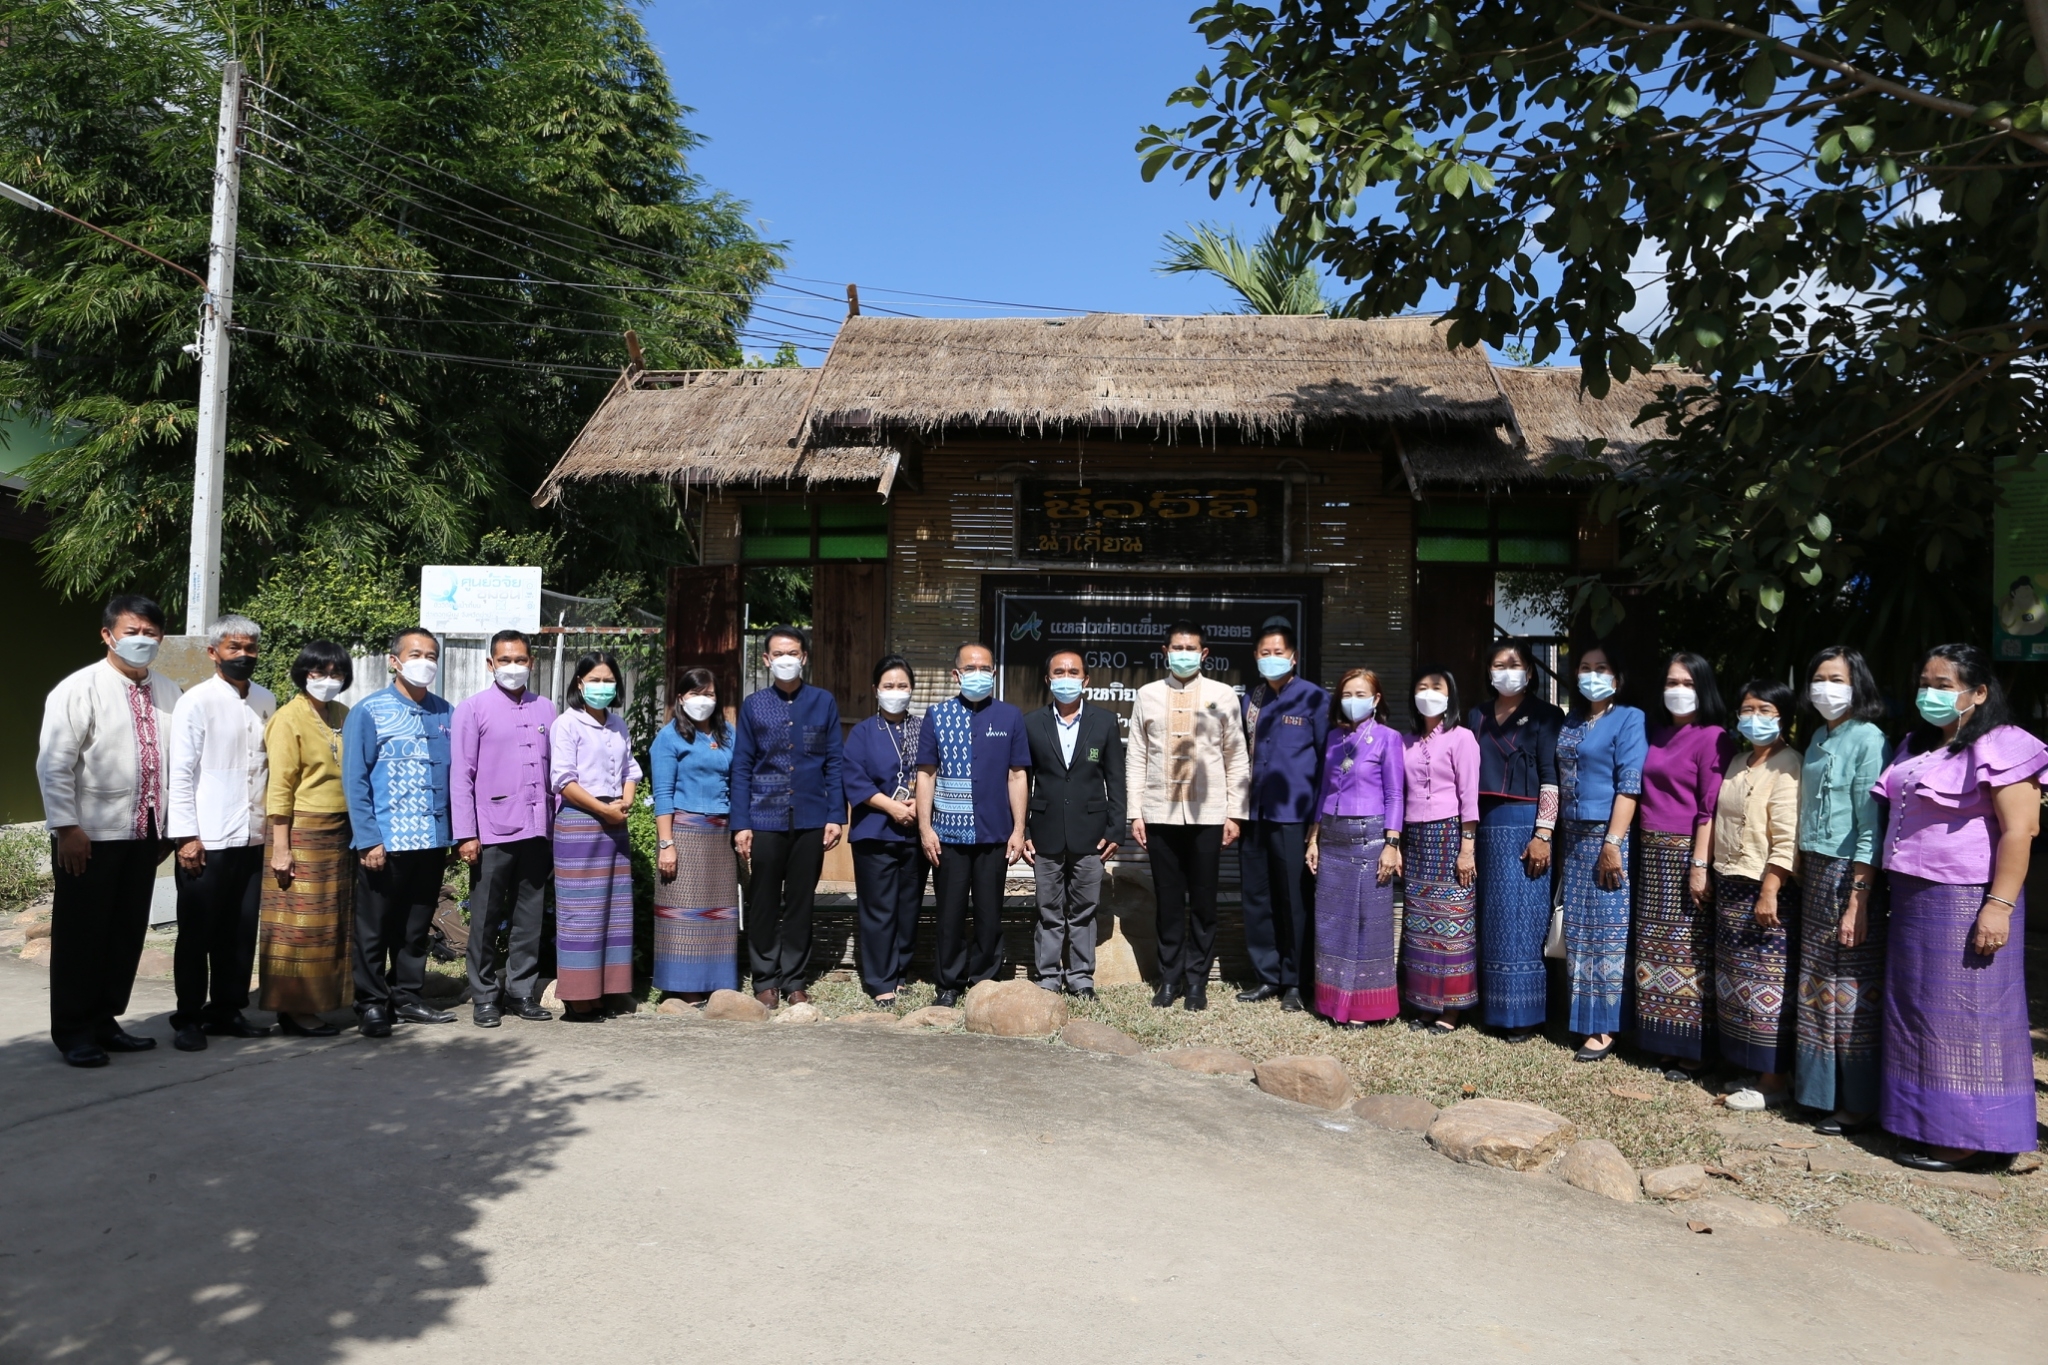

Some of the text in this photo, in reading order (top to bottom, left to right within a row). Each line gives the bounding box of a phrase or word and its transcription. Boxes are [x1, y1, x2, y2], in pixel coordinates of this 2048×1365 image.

[1043, 488, 1258, 519] ชีววิถี
[461, 572, 522, 592] ศูนย์วิจัย
[1085, 651, 1127, 669] GRO
